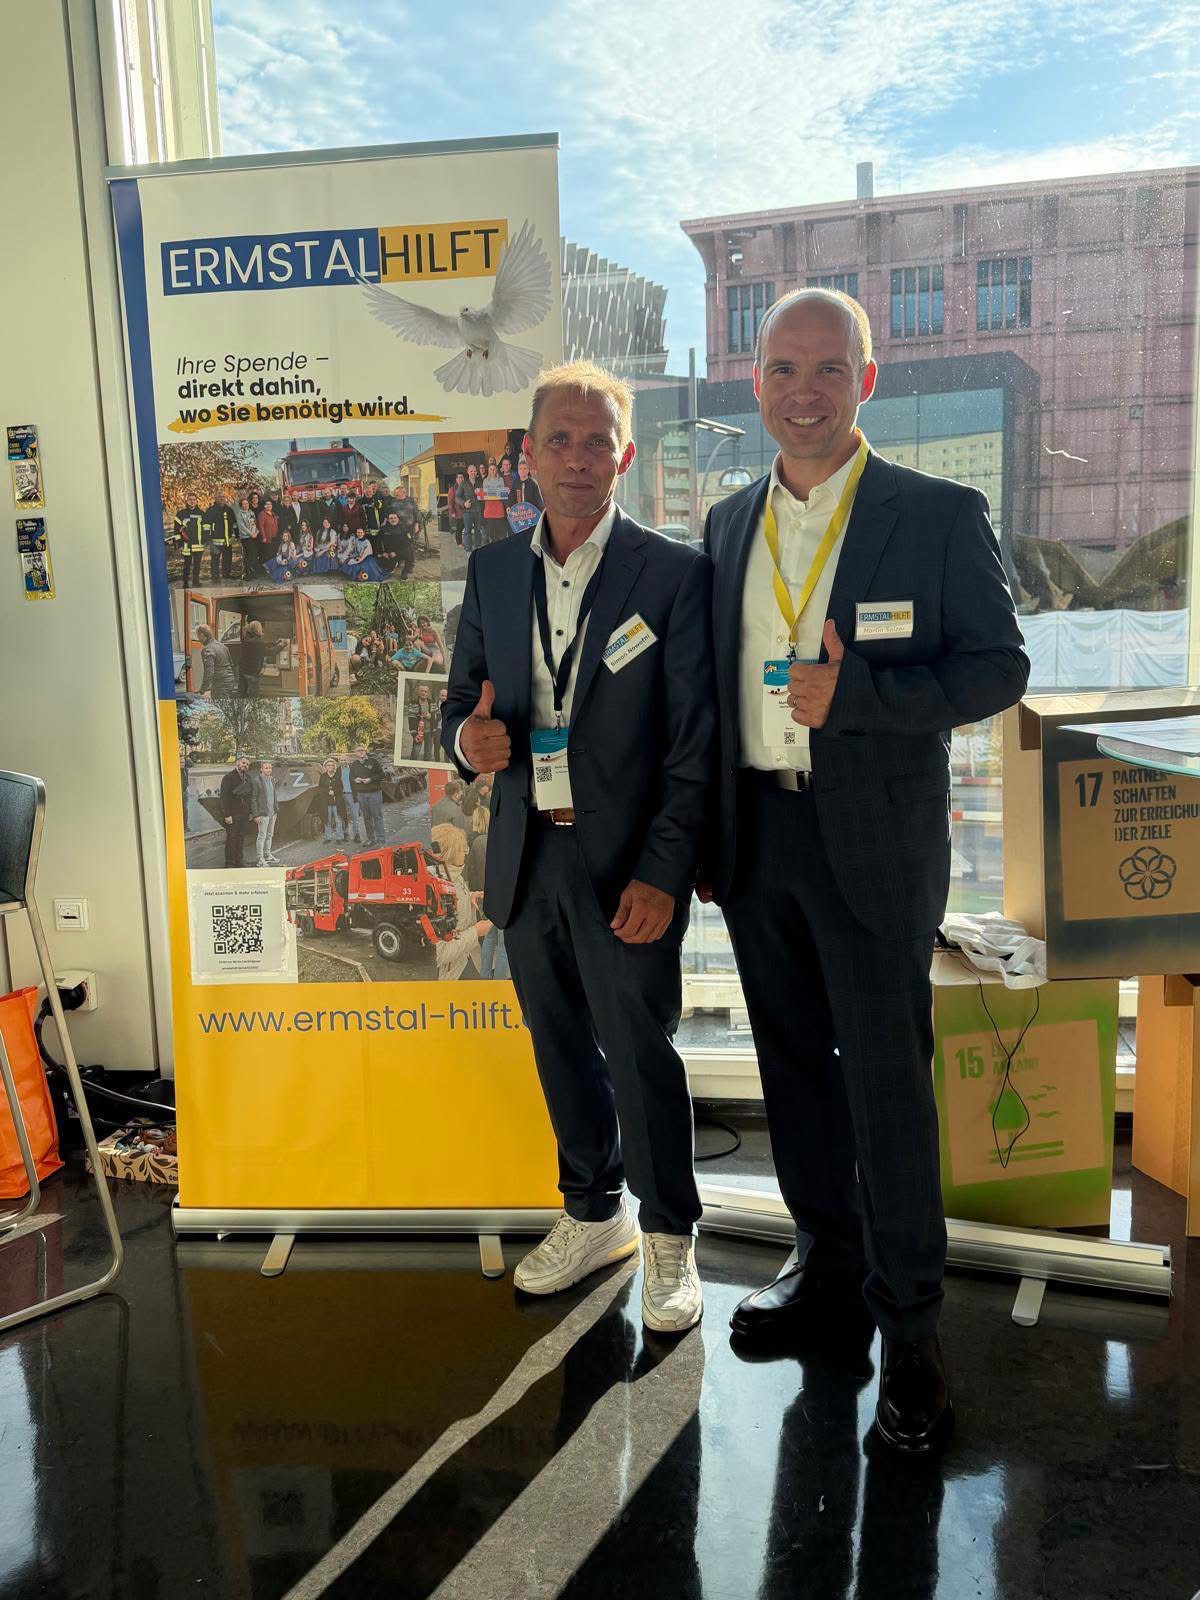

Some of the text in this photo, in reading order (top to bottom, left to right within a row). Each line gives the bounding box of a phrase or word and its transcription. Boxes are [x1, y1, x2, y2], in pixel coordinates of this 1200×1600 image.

[176, 356, 216, 375] Ihre
[224, 352, 308, 377] Spende
[178, 375, 322, 399] direkt dahin,
[179, 396, 415, 424] wo Sie benötigt wird.
[610, 652, 628, 667] Simon
[1075, 771, 1104, 807] 17
[1113, 785, 1176, 805] SCHAFTEN
[1114, 804, 1200, 823] ZUR ERREICHU
[1114, 824, 1172, 842] DER ZIELE
[402, 887, 412, 895] 33
[198, 1001, 528, 1033] www.ermstal-hilft.
[955, 1045, 985, 1080] 15
